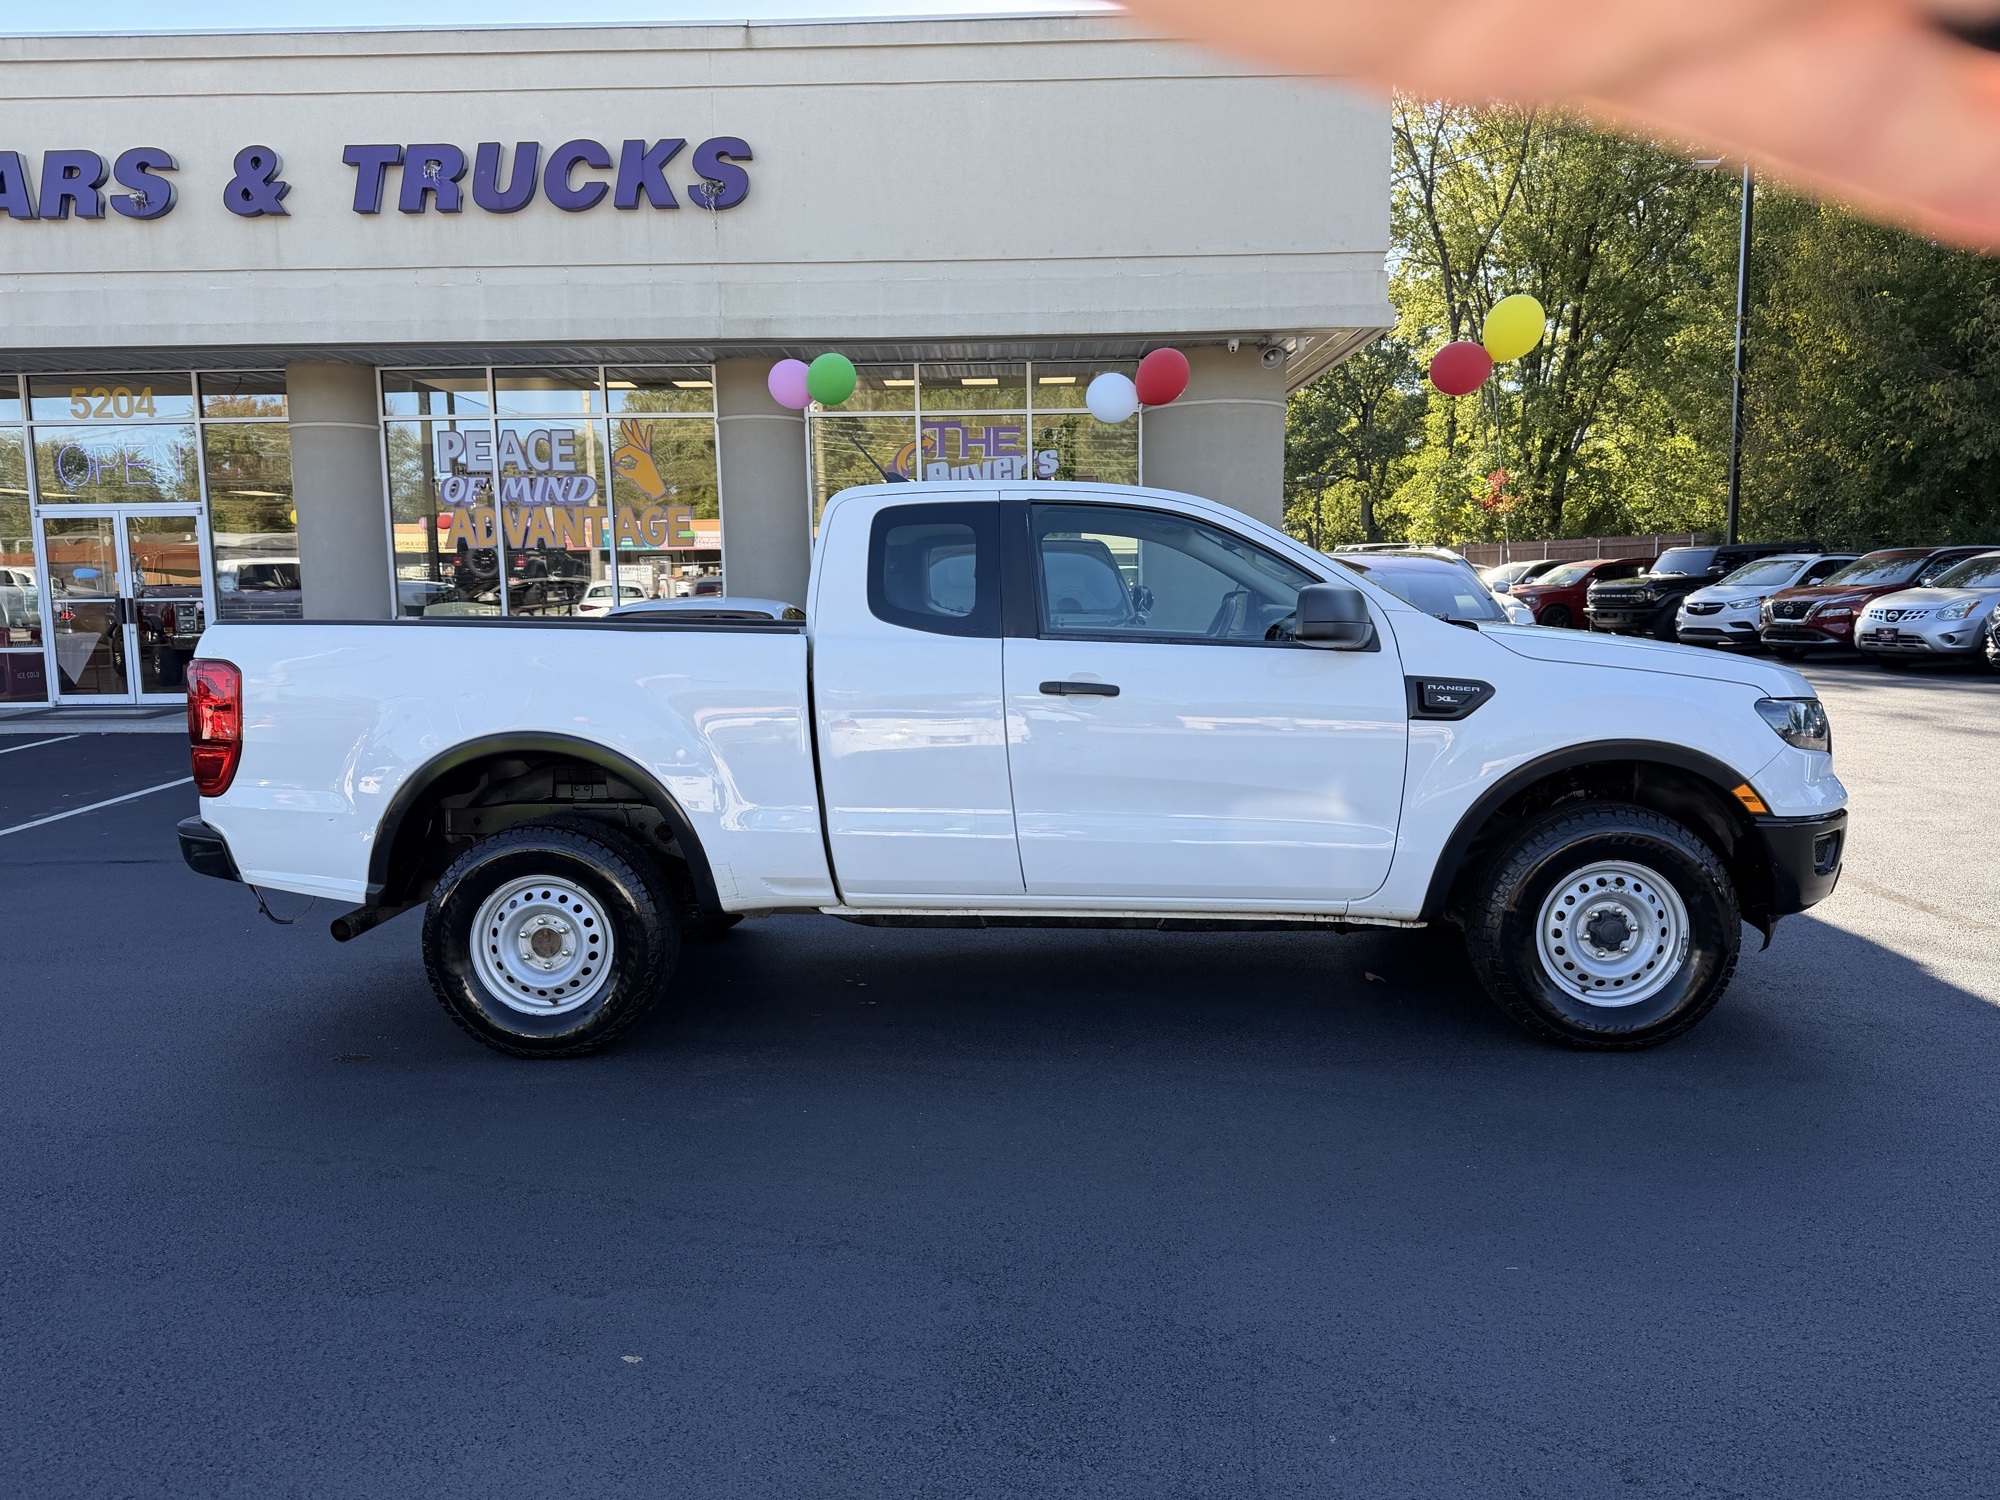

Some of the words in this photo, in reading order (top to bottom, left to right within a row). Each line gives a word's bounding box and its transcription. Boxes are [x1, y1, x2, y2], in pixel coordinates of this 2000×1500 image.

[223, 145, 292, 217] &
[342, 136, 753, 214] TRUCKS
[70, 386, 156, 419] 5204
[437, 429, 576, 473] PEACE
[922, 420, 1022, 459] THE
[57, 443, 183, 488] OPEN
[440, 475, 487, 506] OF
[501, 475, 597, 506] MIND
[446, 505, 695, 549] ADVANTAGE
[26, 671, 40, 679] COLD
[1427, 684, 1480, 692] RANGER
